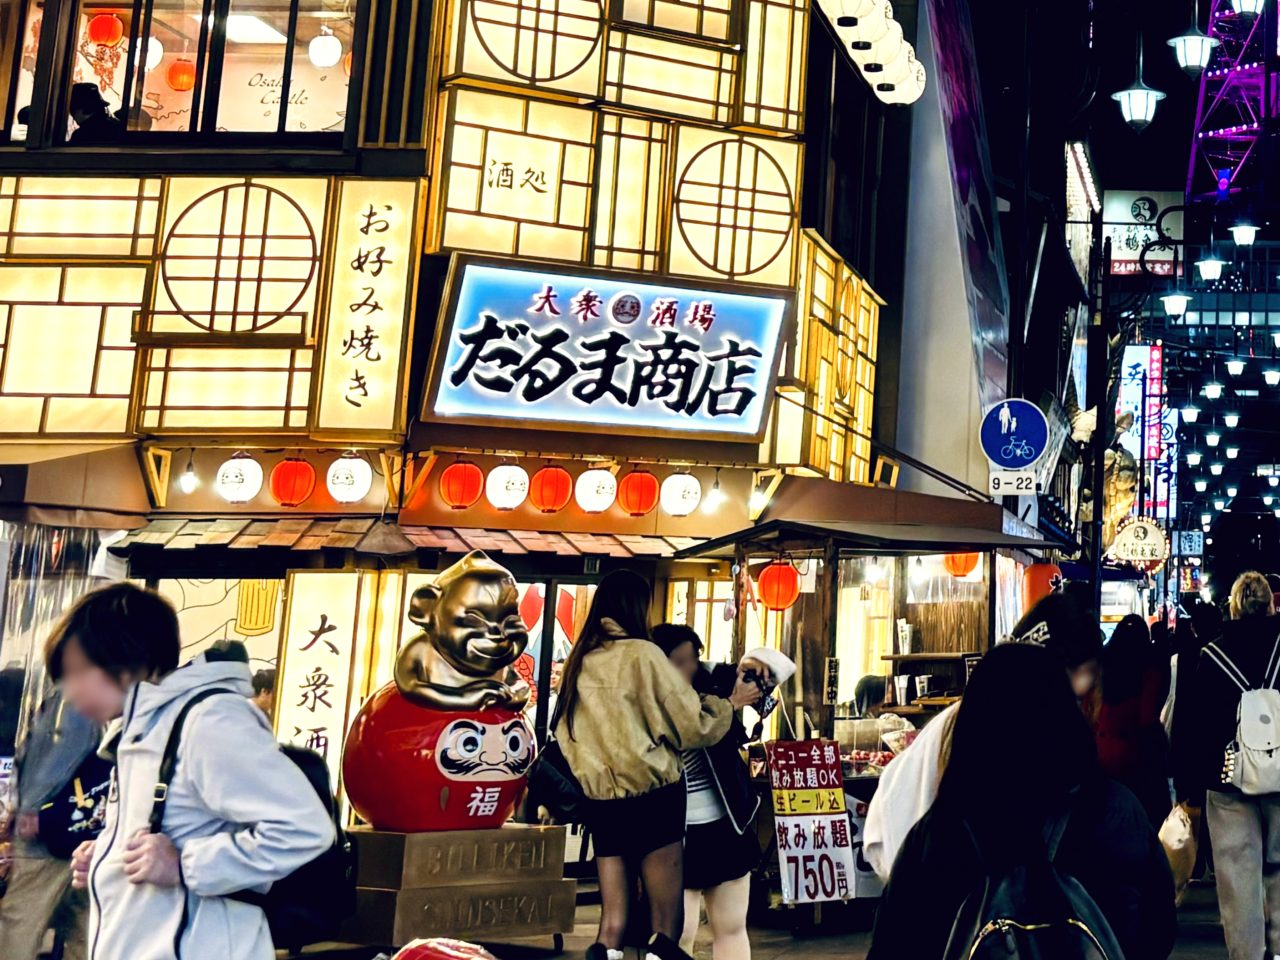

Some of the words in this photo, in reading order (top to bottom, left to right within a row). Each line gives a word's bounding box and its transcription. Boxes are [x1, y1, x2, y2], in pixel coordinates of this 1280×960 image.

[248, 72, 293, 87] Osa
[260, 89, 308, 105] Catle
[486, 158, 550, 194] 酒処
[341, 204, 394, 408] お好み焼き
[651, 298, 717, 333] 酒場
[449, 314, 763, 418] だるま商店
[770, 745, 836, 765] メニュー全部
[771, 768, 839, 788] 飲み放題OK
[467, 786, 501, 817] 福
[776, 792, 840, 812] 生ビール込
[777, 820, 849, 851] 飲み放題
